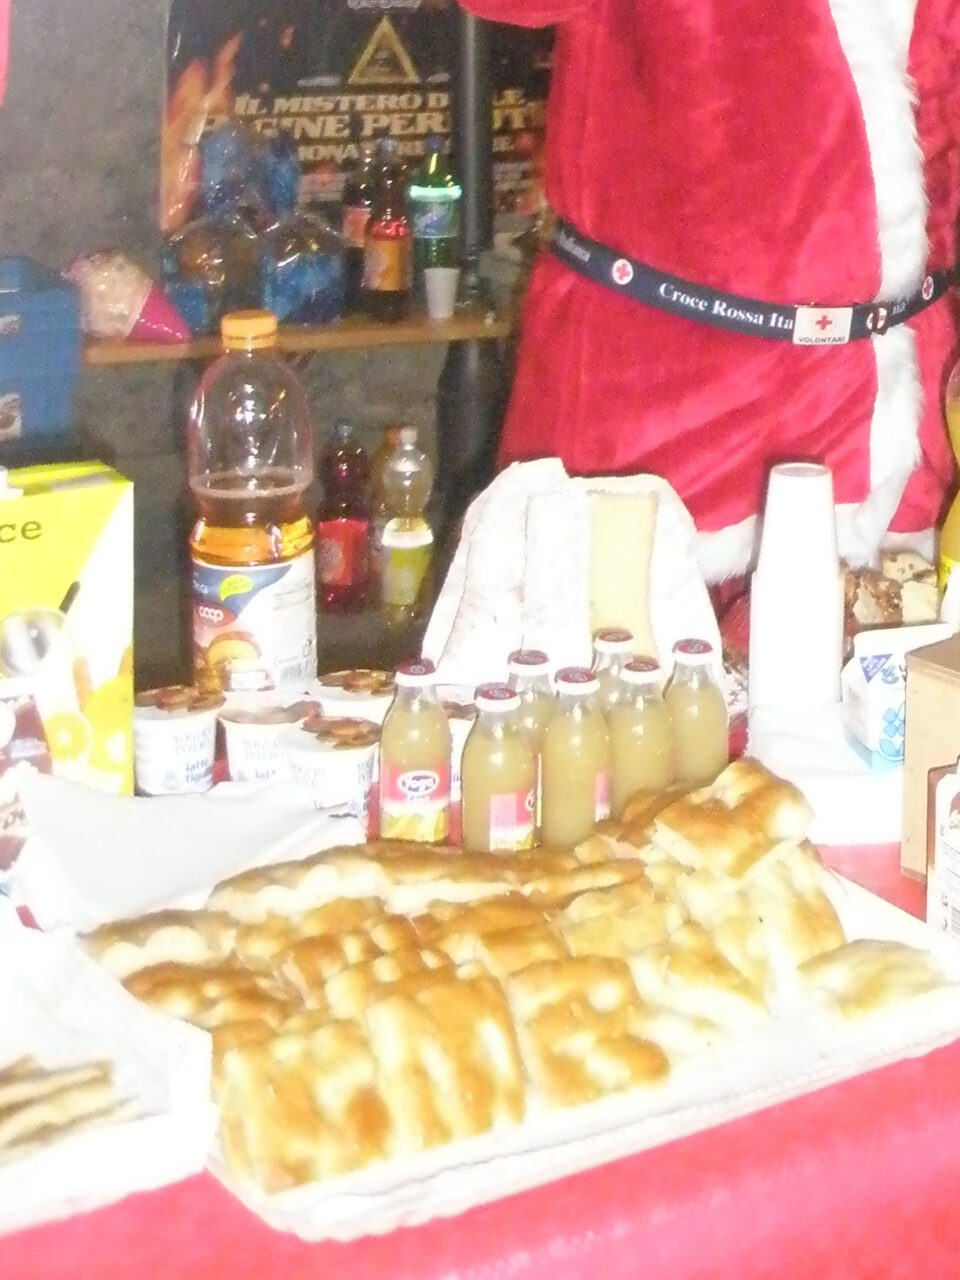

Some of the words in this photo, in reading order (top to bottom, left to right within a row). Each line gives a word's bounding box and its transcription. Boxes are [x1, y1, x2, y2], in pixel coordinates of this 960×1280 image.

[235, 95, 267, 116] IL
[272, 93, 423, 114] MISTERO
[658, 282, 709, 312] Croce
[711, 299, 766, 327] Rossa
[798, 336, 846, 345] VOLONTARI
[198, 605, 224, 623] coop
[402, 773, 434, 794] Yoga
